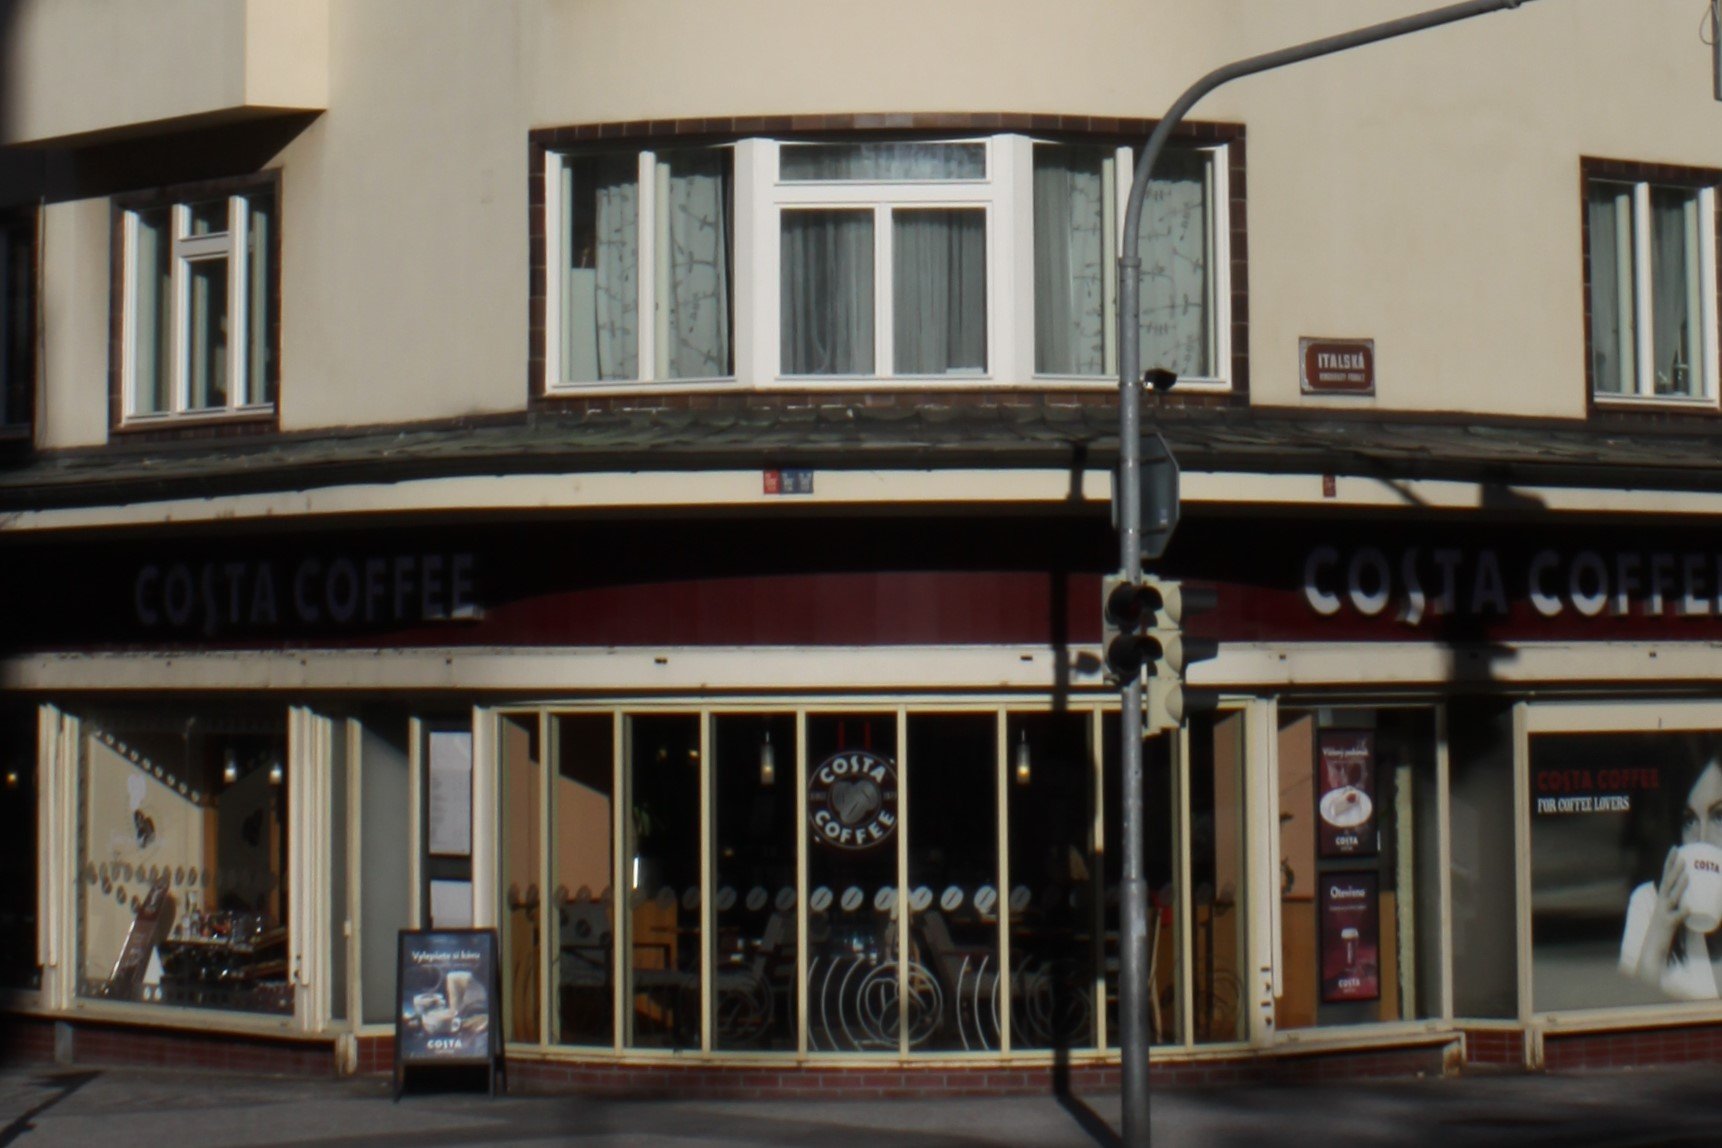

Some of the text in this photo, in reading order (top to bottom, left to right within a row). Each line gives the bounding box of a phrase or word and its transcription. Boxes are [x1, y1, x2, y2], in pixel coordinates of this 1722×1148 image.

[1318, 352, 1365, 370] ITALSKÁ
[135, 553, 484, 638] COSTA COFFEE
[1304, 546, 1722, 626] COSTA COFFE
[819, 755, 886, 784] COSTA
[1537, 767, 1660, 792] COSTA COFFEE
[1537, 795, 1630, 813] FOR COFFEE LOVERS
[815, 810, 895, 844] COFFEE
[1693, 859, 1720, 873] COSTA
[427, 1038, 462, 1050] COSTA
